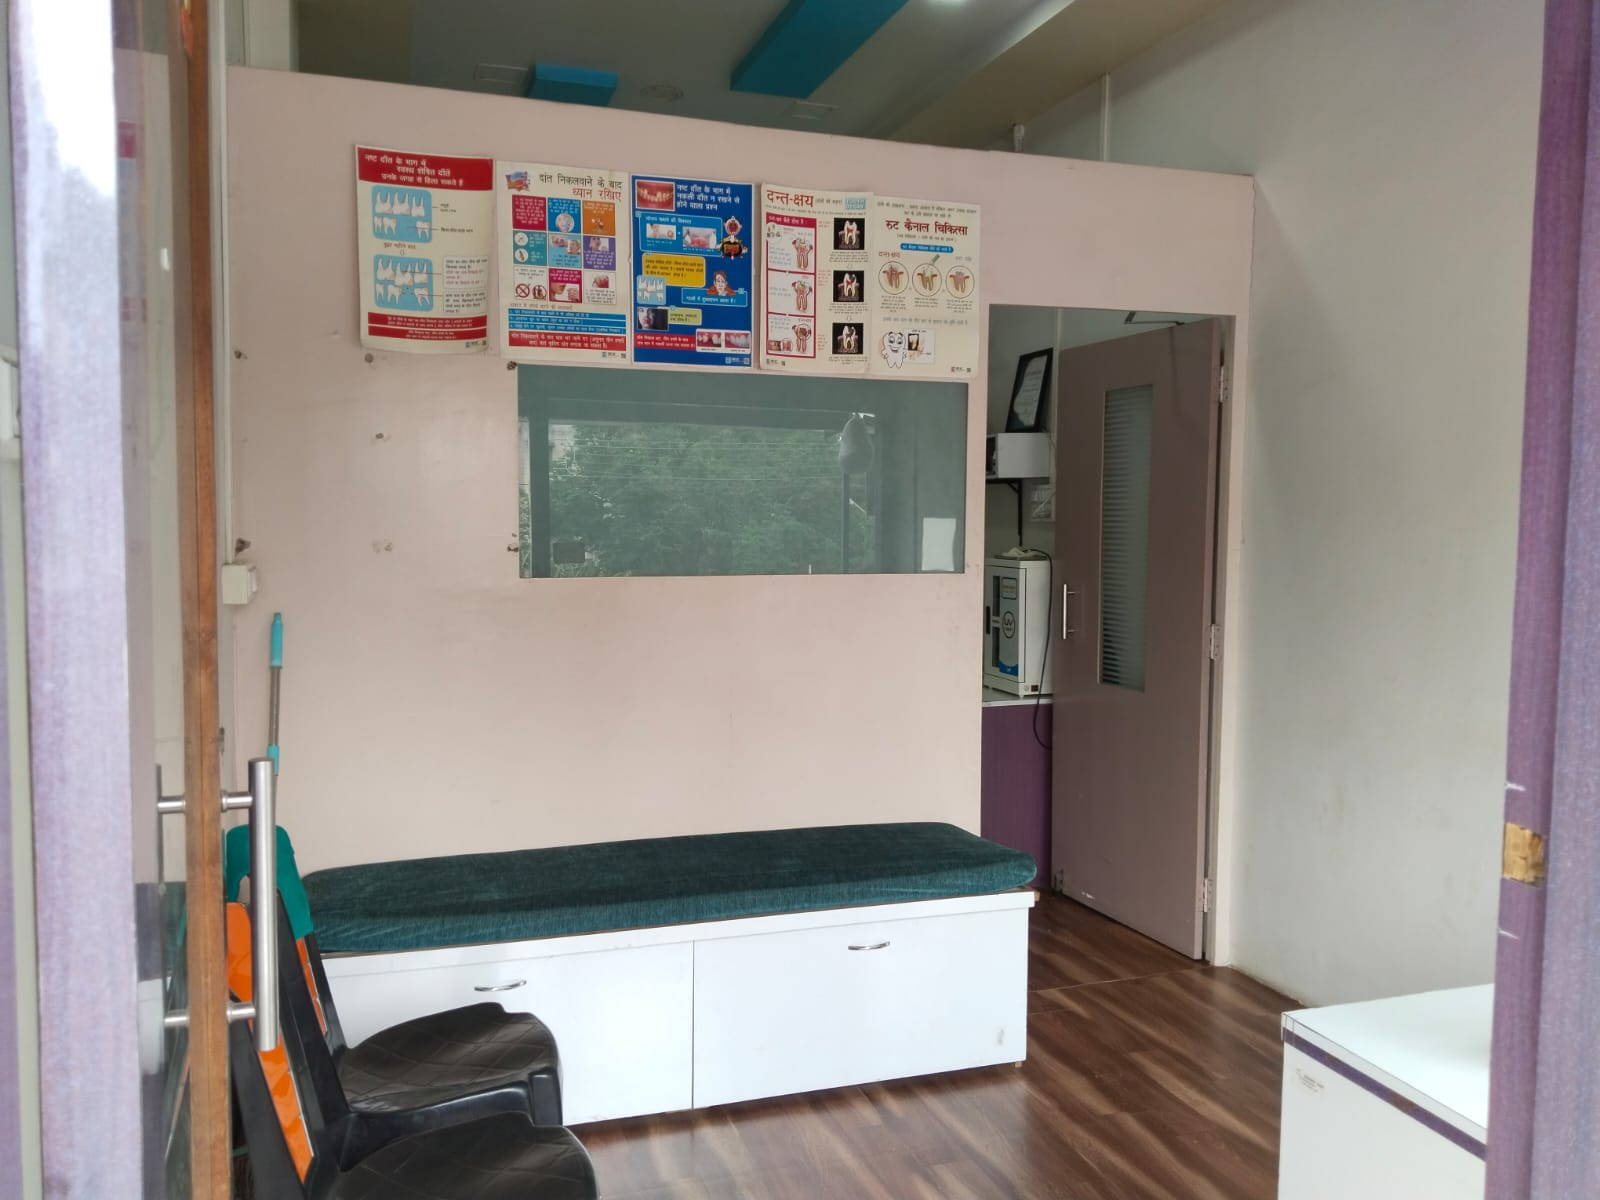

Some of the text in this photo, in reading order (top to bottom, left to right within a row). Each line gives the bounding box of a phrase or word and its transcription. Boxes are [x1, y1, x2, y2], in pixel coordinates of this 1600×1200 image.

[395, 155, 402, 165] के
[558, 173, 593, 186] निकलवाने
[597, 177, 604, 188] के
[608, 180, 623, 189] बाद
[572, 187, 621, 202] ध्यान रखिए
[766, 189, 814, 208] दन्त-क्षय
[935, 221, 968, 236] चिकित्सा
